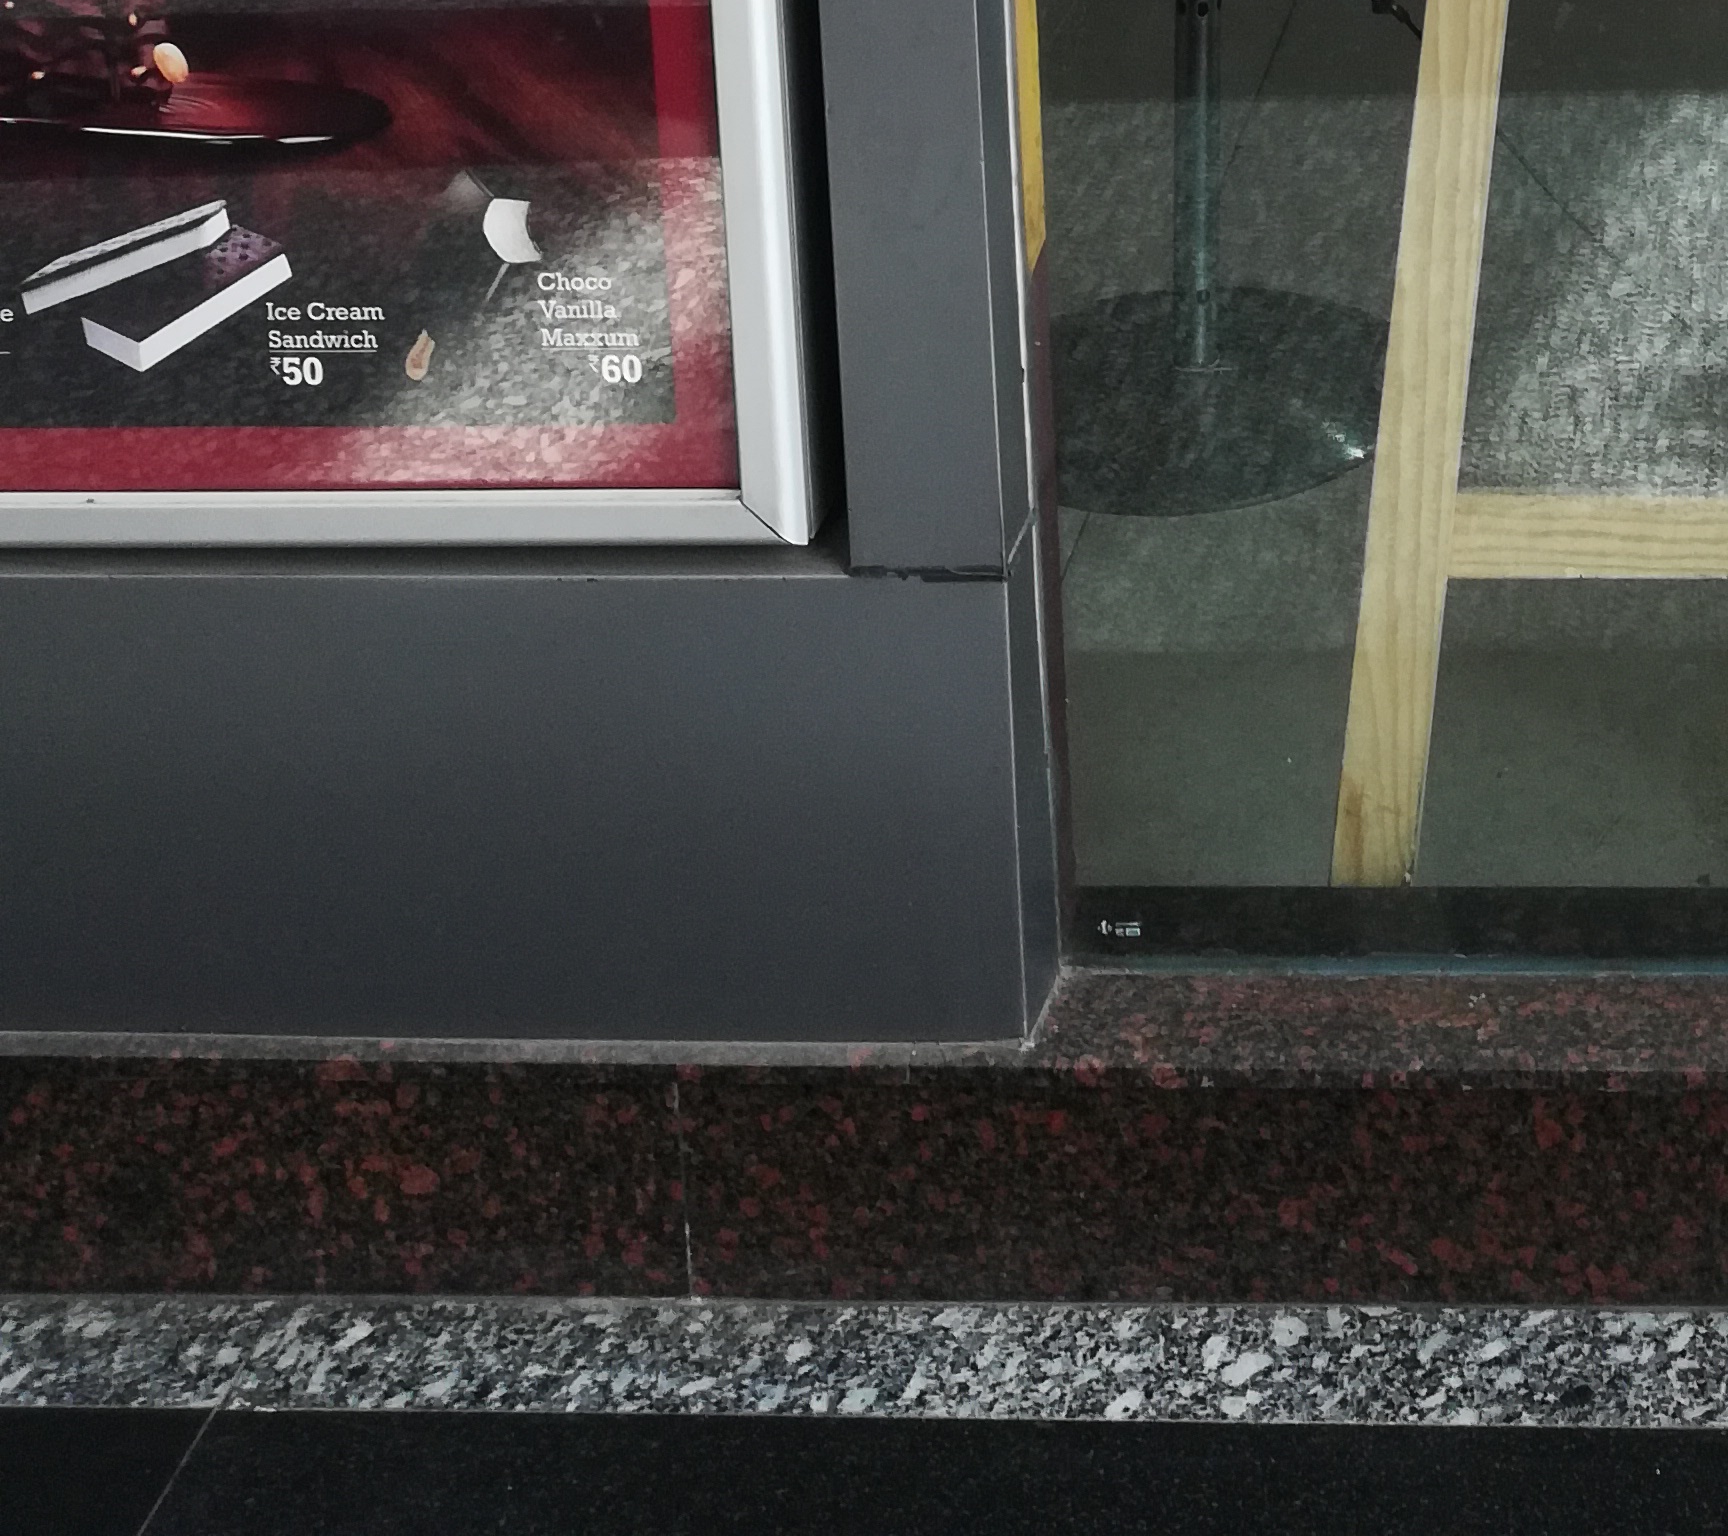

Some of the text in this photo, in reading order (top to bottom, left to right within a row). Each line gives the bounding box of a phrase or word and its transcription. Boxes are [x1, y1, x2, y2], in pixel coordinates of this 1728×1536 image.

[538, 272, 611, 292] Choco
[266, 303, 384, 322] Ice Cream
[539, 299, 617, 320] Vanilla
[269, 330, 378, 349] Sandwich
